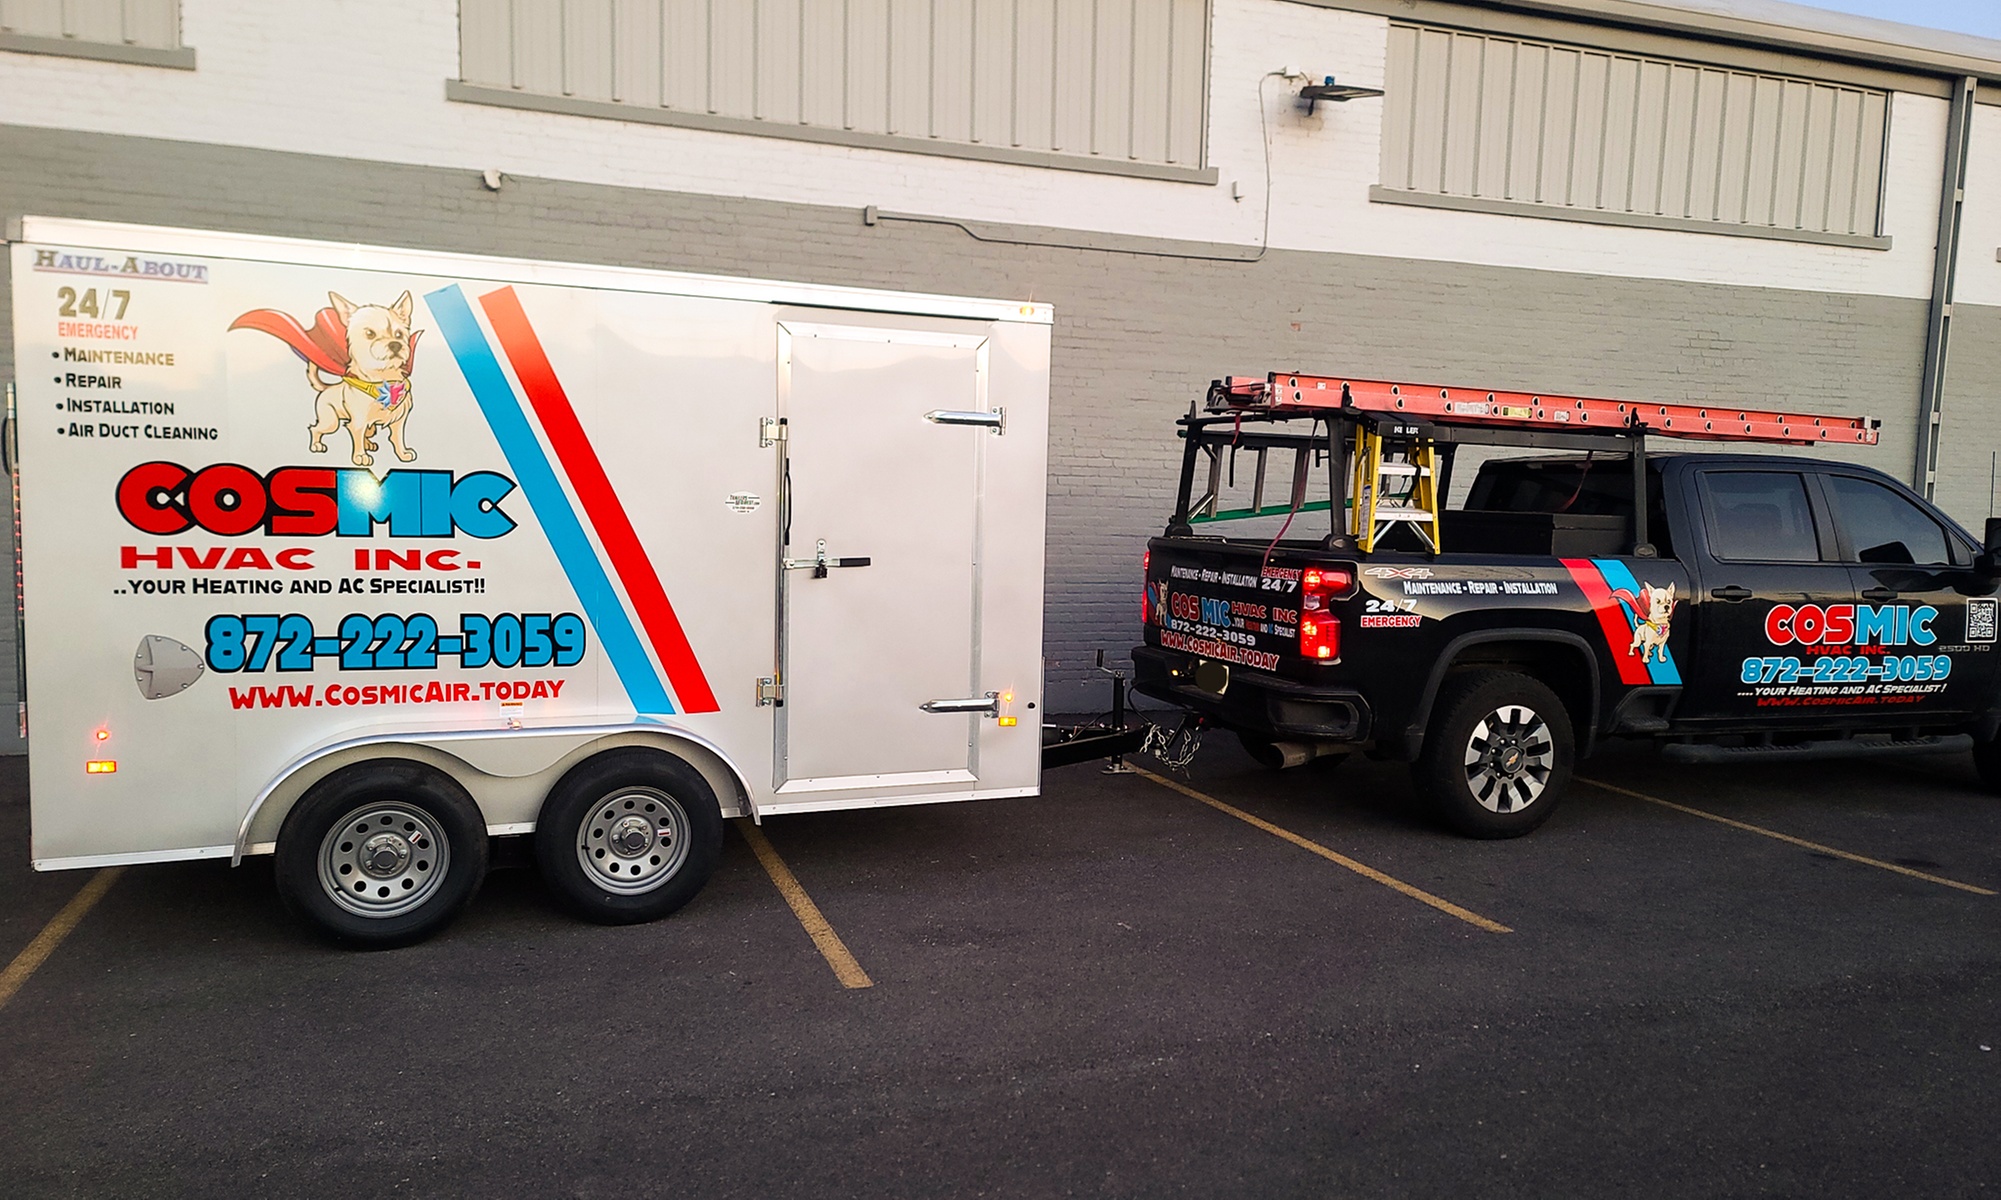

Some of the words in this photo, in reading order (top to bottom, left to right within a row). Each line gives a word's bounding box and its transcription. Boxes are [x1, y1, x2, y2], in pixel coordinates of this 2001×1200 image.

[34, 249, 208, 279] HAUL-ABOUT
[57, 286, 131, 320] 24/7
[58, 322, 138, 340] EMERGENCY
[64, 347, 175, 366] MAINTENANCE
[66, 373, 122, 389] REPAIR
[67, 398, 175, 415] INSTALLATION
[68, 423, 94, 438] AIR
[99, 423, 139, 439] DUCT
[144, 424, 219, 441] CLEANING
[115, 460, 518, 539] COSMIC
[120, 546, 315, 571] HVAC
[354, 548, 482, 571] INC.
[1261, 565, 1303, 581] EMERGENCY
[1364, 567, 1434, 580] 4X4
[191, 577, 287, 595] HEATING
[290, 578, 333, 595] AND
[338, 578, 365, 595] AC
[370, 577, 486, 595] SPECIALIST!!
[1261, 578, 1298, 593] 24/7
[1403, 580, 1463, 596] MAINTENANCE
[1468, 580, 1499, 596] REPAIR
[1504, 581, 1558, 595] INSTALLATION
[1231, 600, 1267, 620] HVAC
[1272, 606, 1298, 625] INC
[1365, 599, 1418, 613] 24/7
[1360, 614, 1422, 628] EMERGENCY
[1765, 604, 1940, 646] COSMIC
[1170, 619, 1256, 646] 872-222-3059
[205, 613, 587, 673] 872-222-3059
[1161, 629, 1280, 672] WWW.COSMICAIR.TODAY
[1806, 645, 1852, 655] HVAC
[1860, 644, 1891, 655] INC.
[1974, 644, 1990, 652] HD
[1740, 655, 1952, 684] 872-222-3059
[229, 679, 565, 710] WWW.COSMICAIR.TODAY
[1788, 685, 1839, 696] HEATING
[1841, 685, 1865, 695] AND
[1866, 685, 1883, 695] AC
[1757, 695, 1926, 707] WWW.COSMICAIR.TODAY
